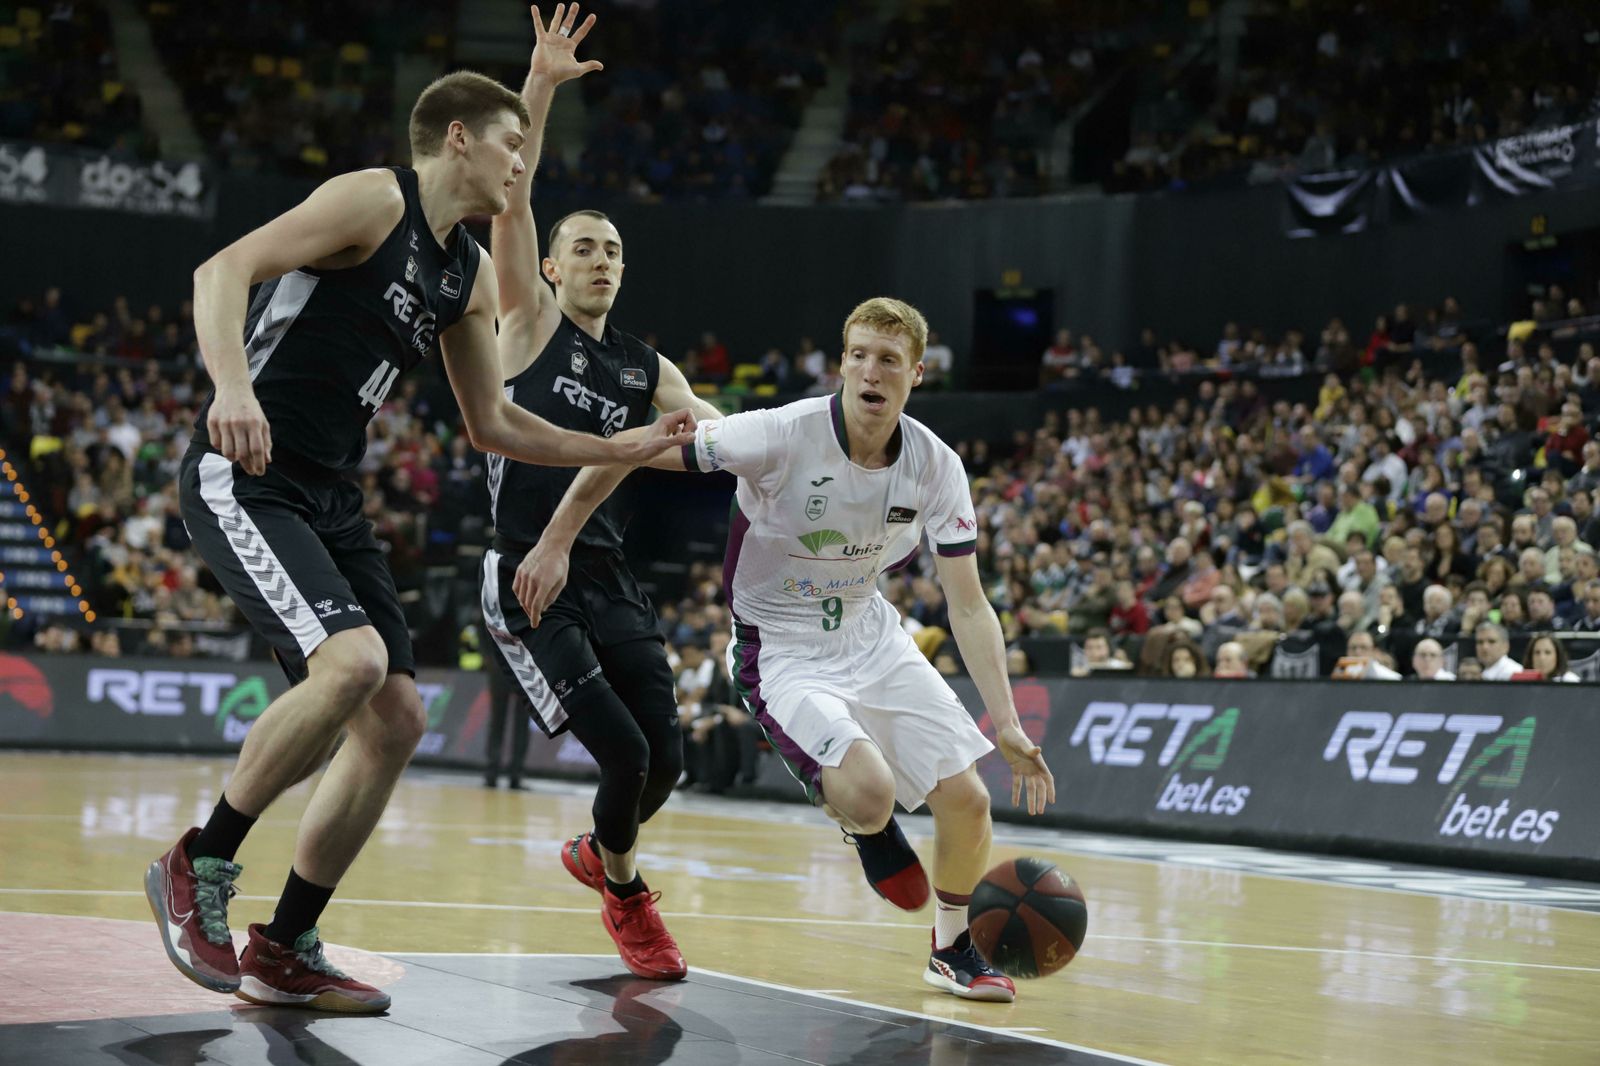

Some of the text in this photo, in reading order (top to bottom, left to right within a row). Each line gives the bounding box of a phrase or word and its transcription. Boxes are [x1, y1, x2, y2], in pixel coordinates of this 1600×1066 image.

[358, 359, 400, 413] 44
[553, 375, 630, 431] RETA
[783, 578, 823, 598] 2020
[822, 597, 844, 630] 9
[86, 667, 271, 734] RETA
[1069, 701, 1241, 785] RETA
[1322, 710, 1537, 805] RETA
[1156, 772, 1252, 816] bet.es
[1439, 792, 1561, 844] bet.es
